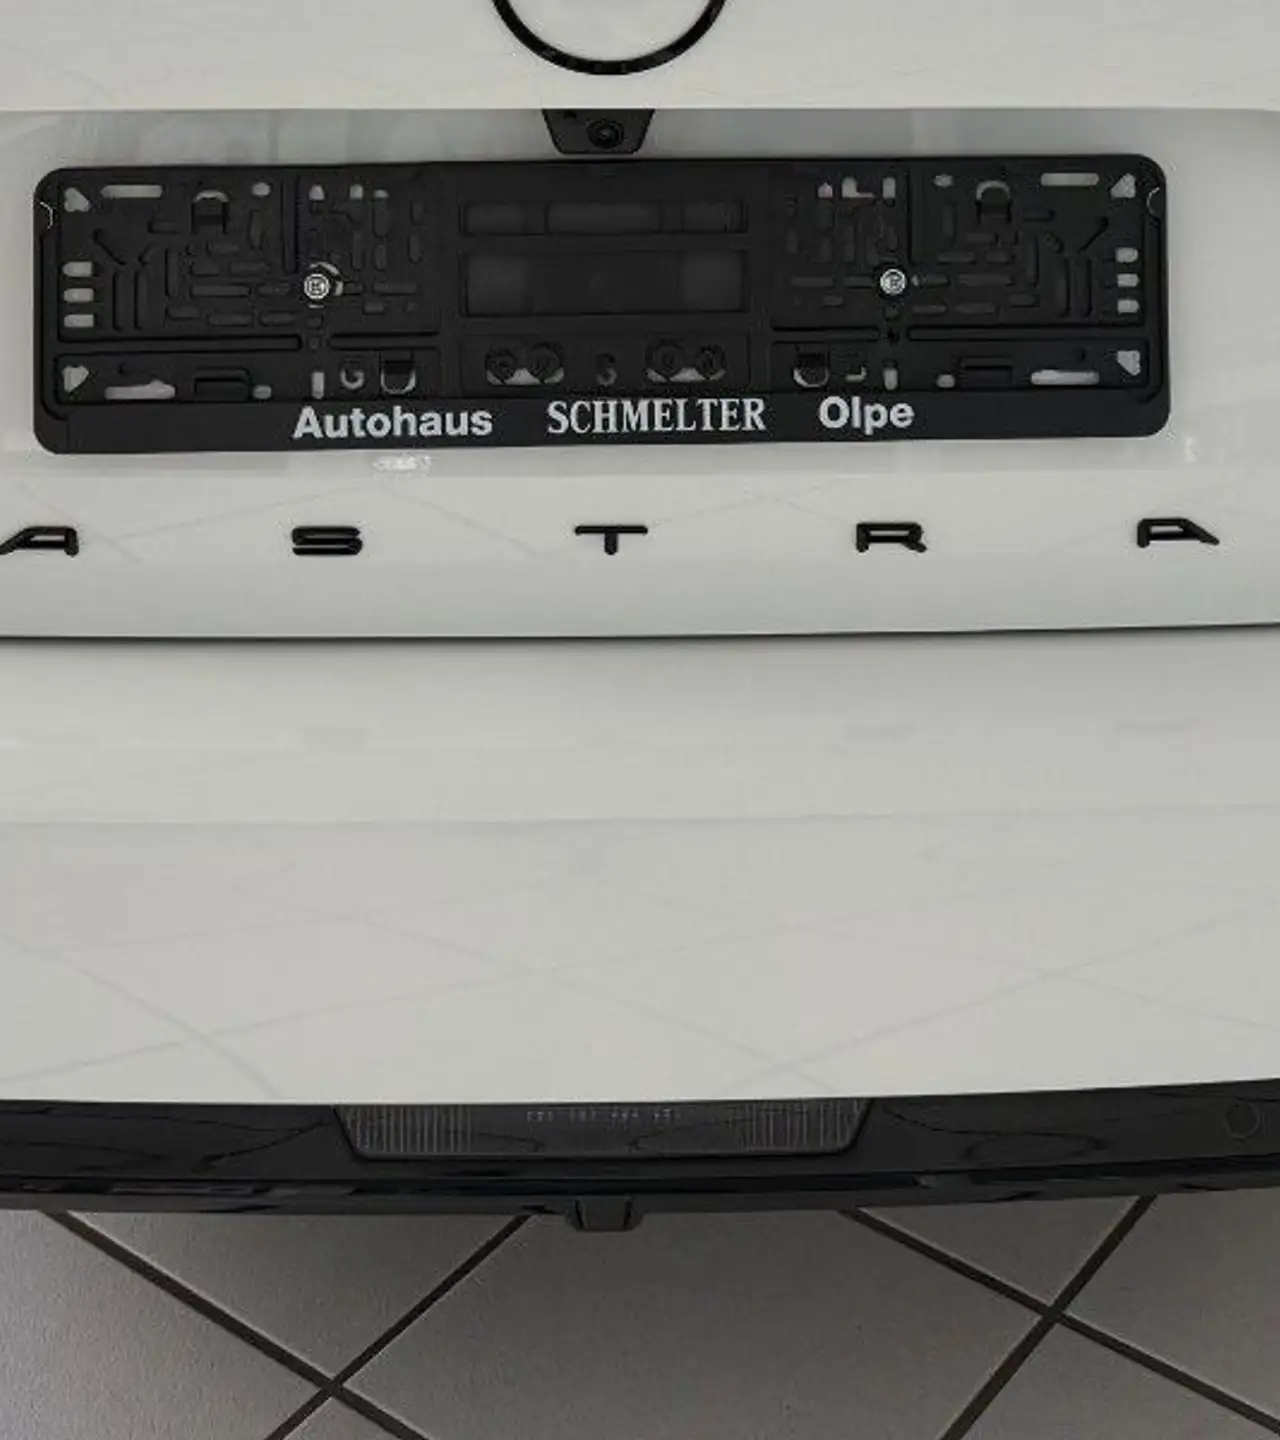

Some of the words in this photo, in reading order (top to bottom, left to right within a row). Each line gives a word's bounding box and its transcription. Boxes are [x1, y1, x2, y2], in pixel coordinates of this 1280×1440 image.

[292, 404, 494, 439] Autohaus
[546, 397, 768, 436] SCHMELTER
[817, 395, 916, 436] Olpe
